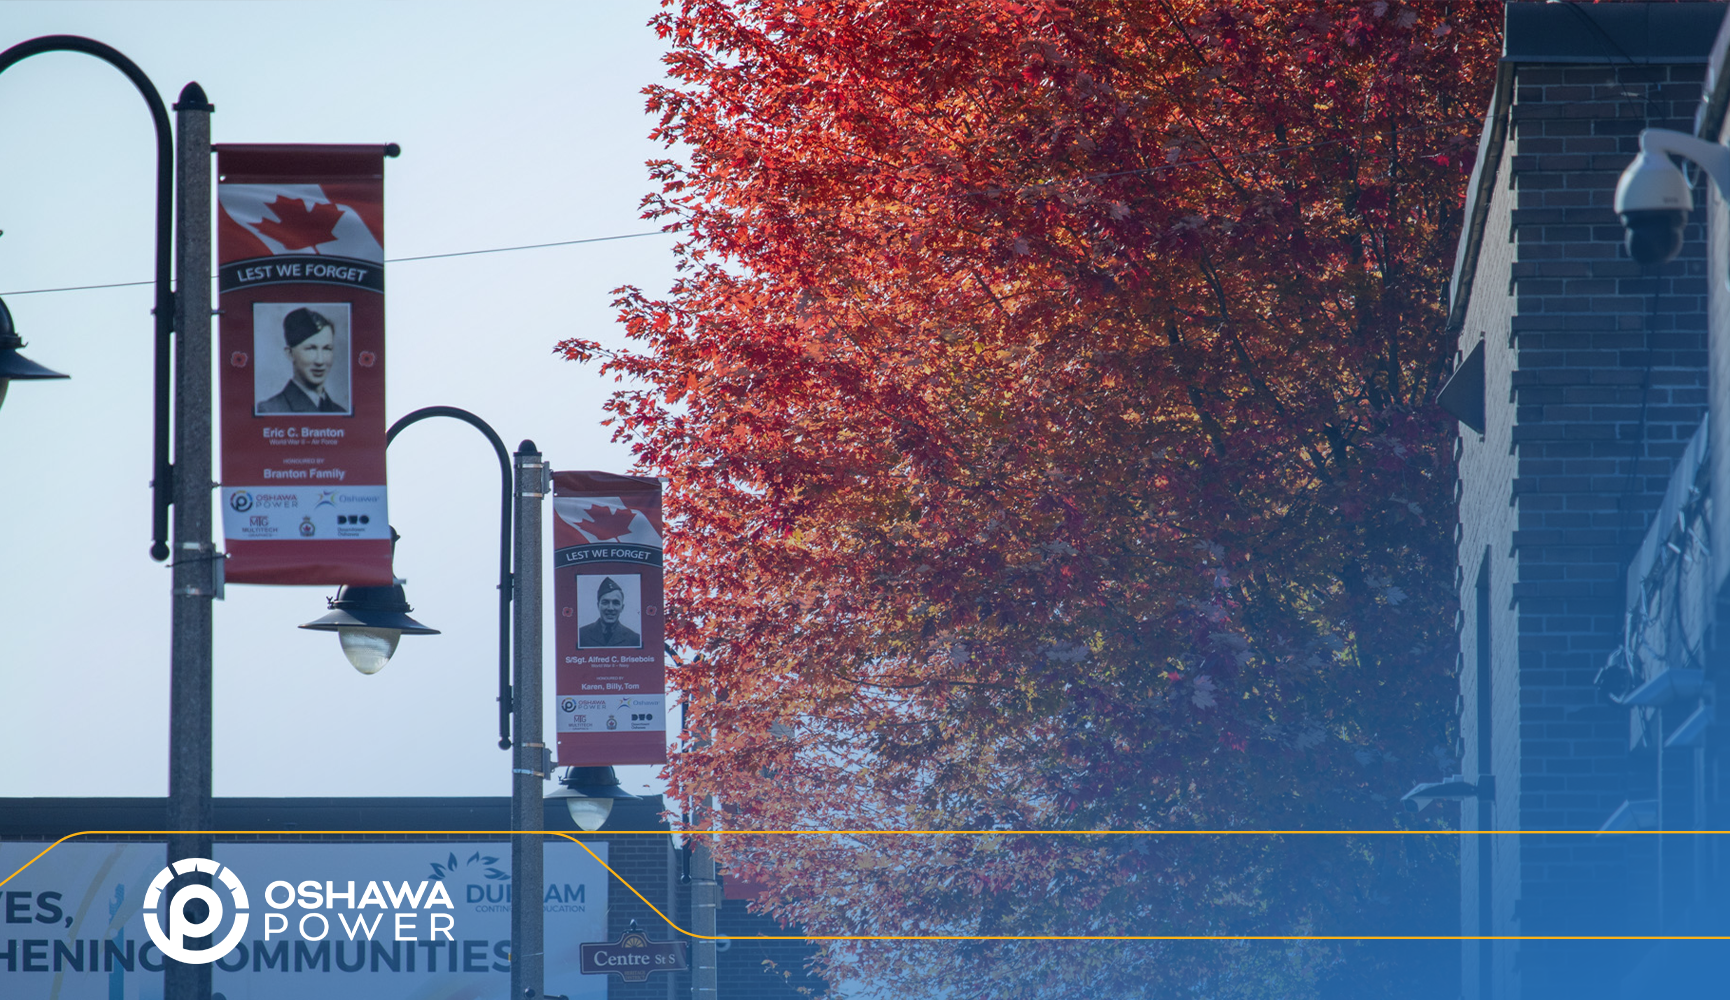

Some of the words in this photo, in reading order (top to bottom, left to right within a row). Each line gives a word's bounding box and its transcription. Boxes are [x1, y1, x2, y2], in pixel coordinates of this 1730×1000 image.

[237, 265, 273, 282] LEST
[276, 264, 301, 277] WE
[305, 264, 367, 282] FORGET
[262, 427, 285, 438] Eric
[287, 428, 299, 438] C.
[301, 427, 344, 438] Branton
[263, 469, 307, 479] Branton
[309, 469, 345, 481] Family
[566, 550, 589, 561] LEST
[592, 549, 608, 557] WE
[611, 549, 651, 560] FORGET
[565, 656, 586, 664] S/Sgt.
[606, 683, 623, 691] Billy,
[466, 884, 585, 903] DUAM
[0, 891, 74, 928] ES,
[214, 939, 512, 973] OMMUNITIES
[593, 950, 650, 967] Centre
[654, 953, 666, 964] St
[668, 953, 676, 964] S
